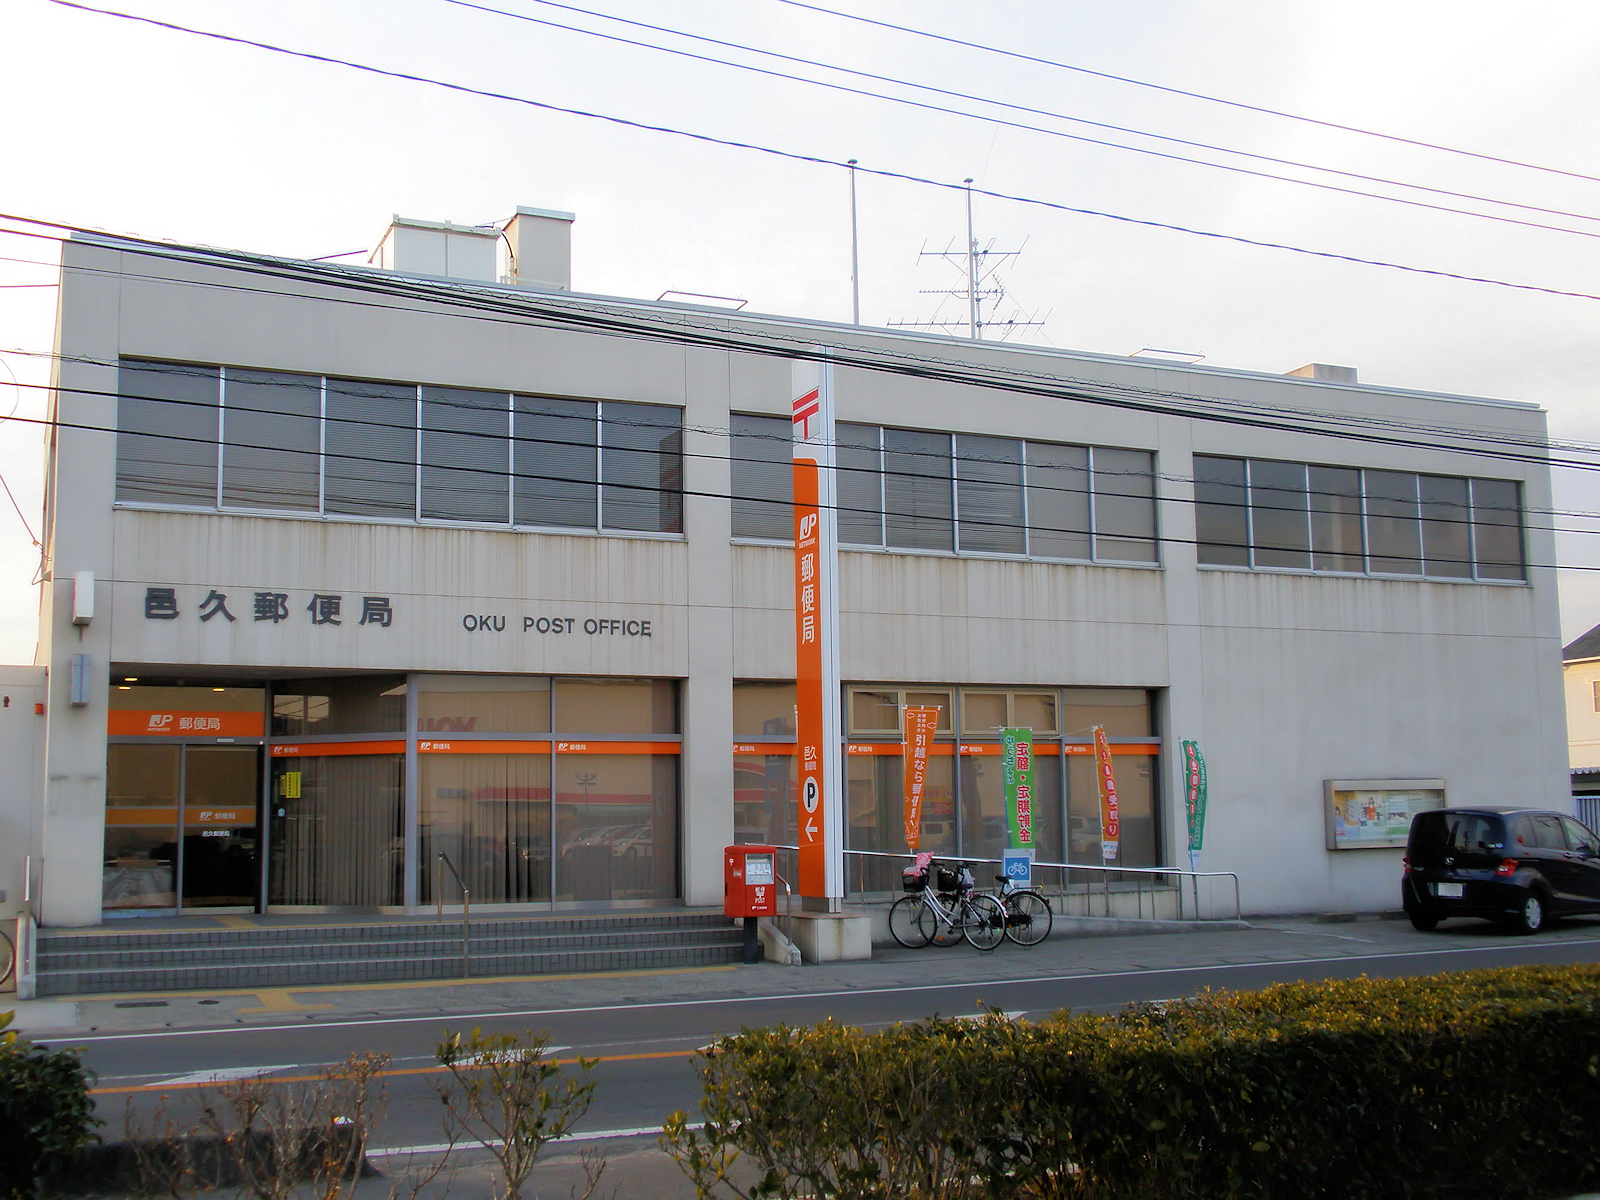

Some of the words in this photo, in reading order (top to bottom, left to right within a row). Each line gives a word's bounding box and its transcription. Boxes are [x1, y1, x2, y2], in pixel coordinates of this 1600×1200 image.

[144, 587, 393, 627] 邑久郵便局
[801, 552, 815, 644] 郵便局
[463, 614, 506, 633] OKU
[523, 616, 575, 635] POST
[584, 618, 652, 637] OFFICE
[178, 716, 221, 731] 郵便局
[803, 745, 818, 761] 邑久
[807, 782, 816, 808] P
